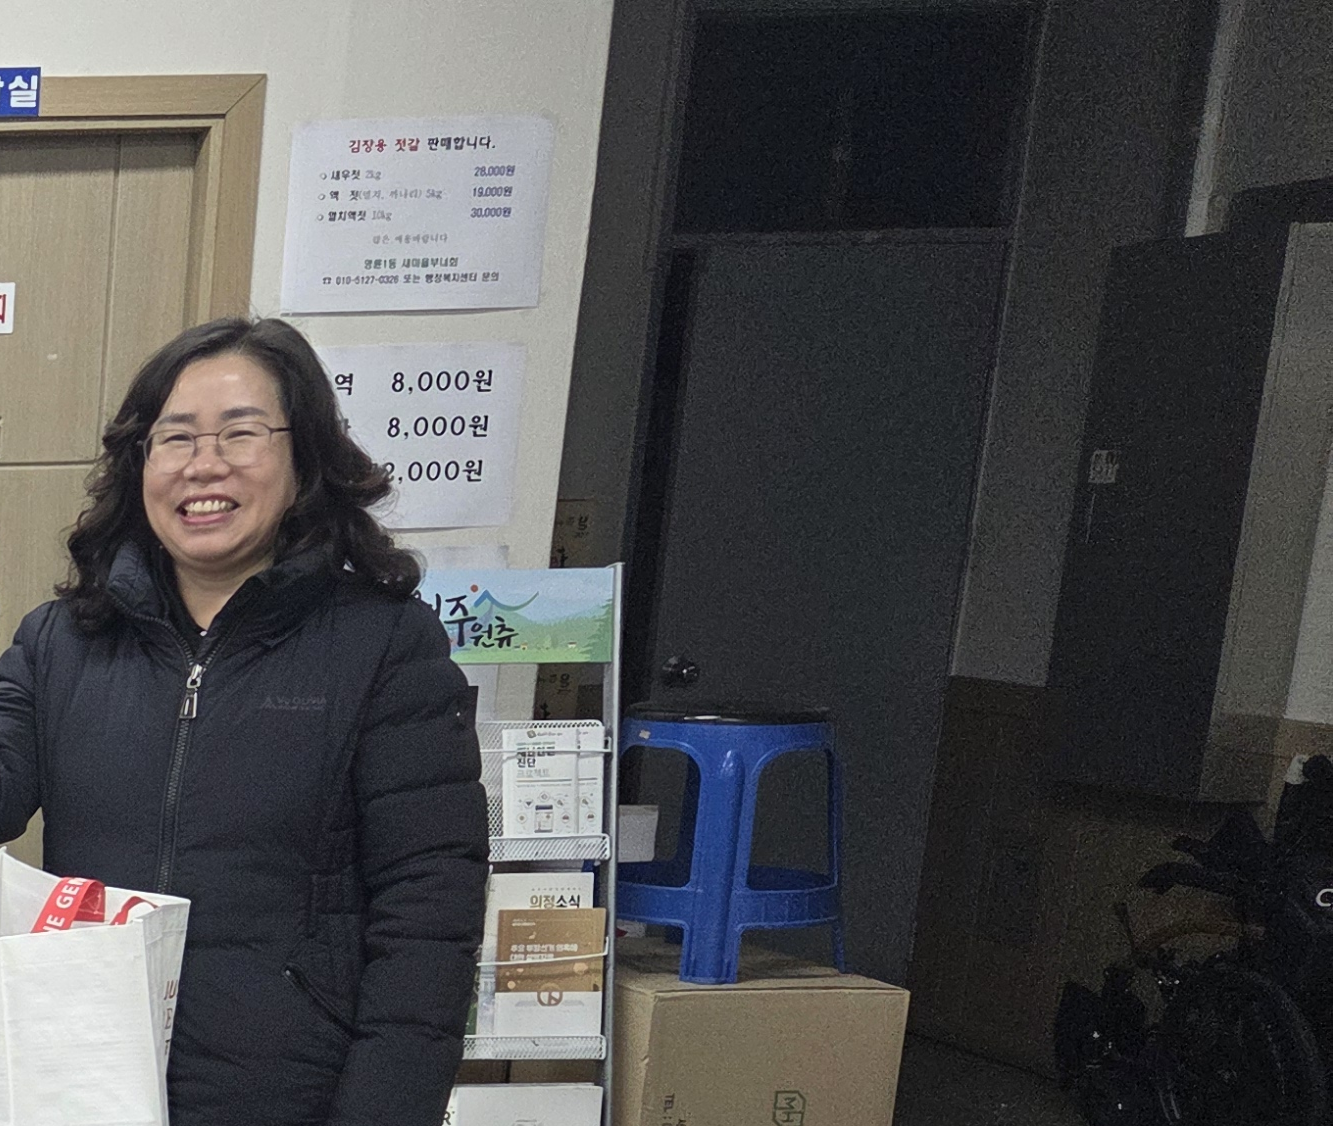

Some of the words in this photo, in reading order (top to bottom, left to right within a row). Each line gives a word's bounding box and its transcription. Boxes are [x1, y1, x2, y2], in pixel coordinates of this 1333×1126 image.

[349, 138, 387, 154] 김장용
[395, 138, 421, 153] 젓갈
[428, 136, 496, 151] 판매합니다.
[391, 369, 493, 394] 8,000원
[386, 414, 489, 439] 8,000원
[664, 1093, 675, 1113] TEL
